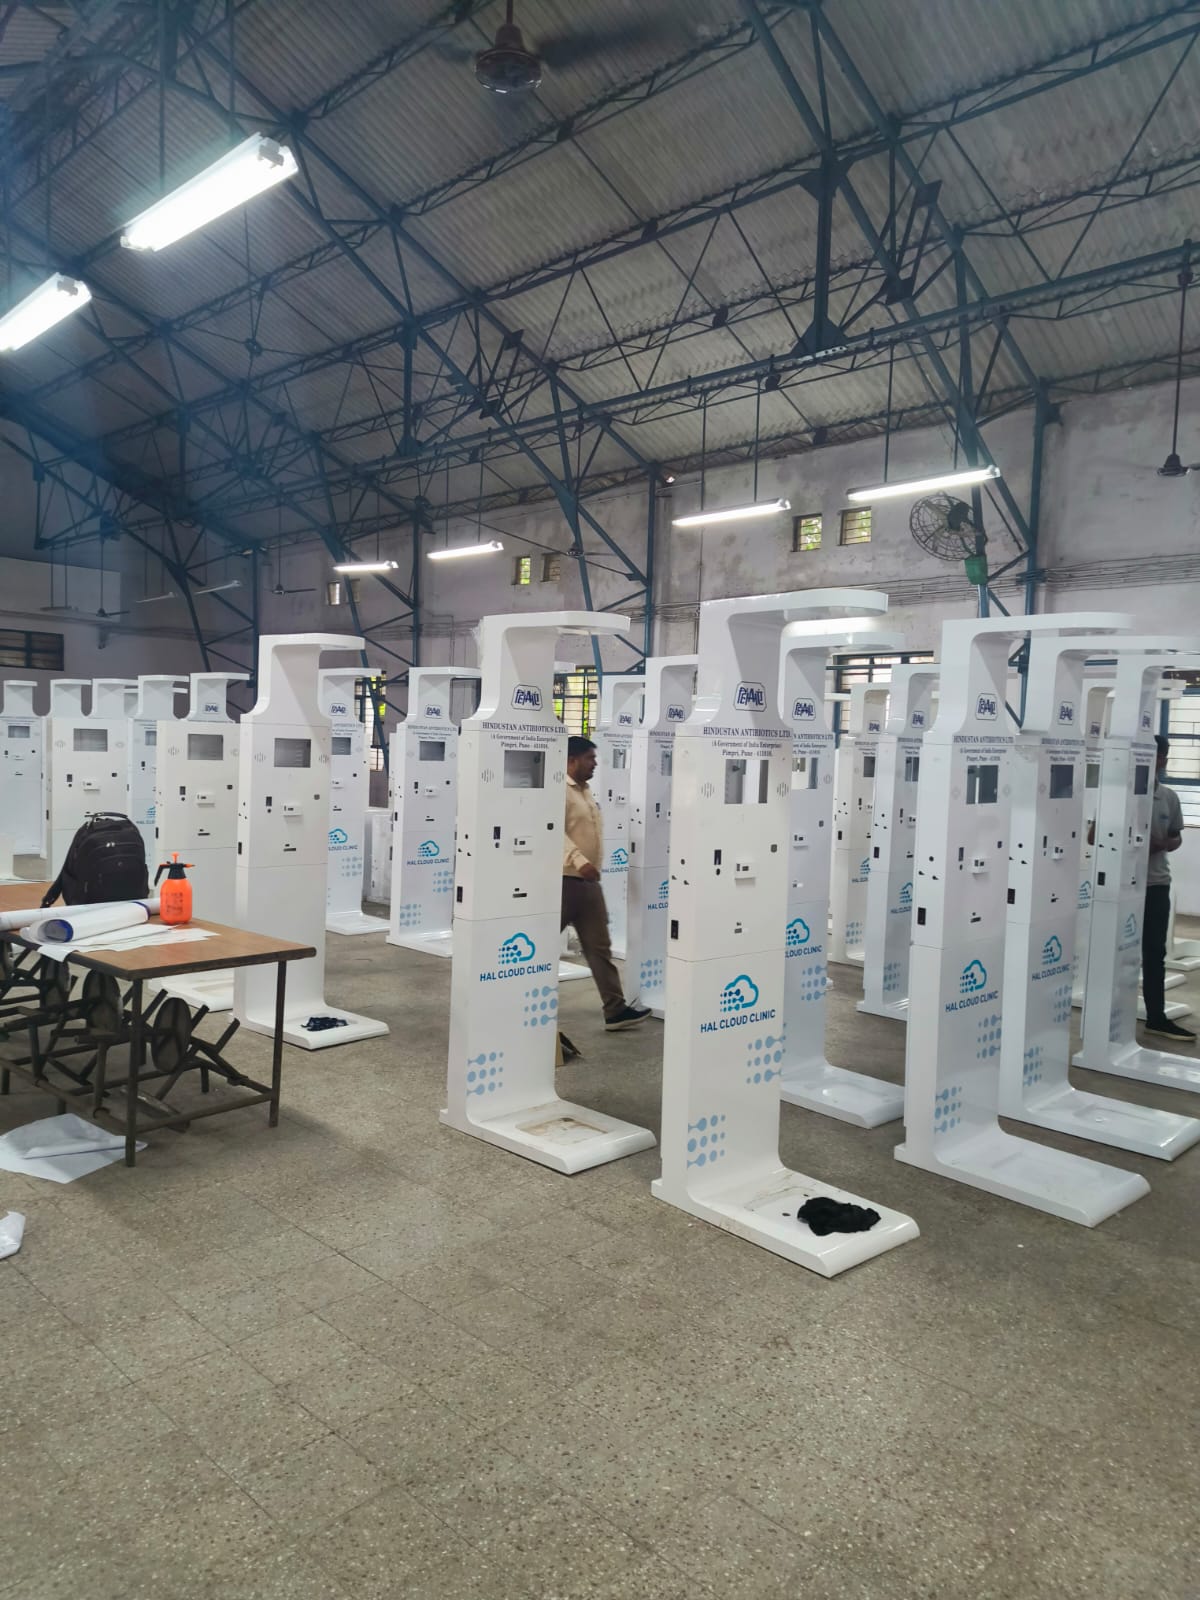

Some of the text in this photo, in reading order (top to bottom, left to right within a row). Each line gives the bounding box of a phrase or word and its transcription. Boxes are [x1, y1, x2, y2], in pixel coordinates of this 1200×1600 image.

[482, 722, 517, 731] HINDUSTAN
[519, 724, 554, 733] ANTIBIOTICS
[703, 726, 740, 737] HINDUSTAN
[740, 728, 778, 738] ANTIBIOTICS
[647, 903, 658, 911] HAL
[803, 945, 822, 955] CLINIC
[479, 963, 552, 982] HAL CLOUD CLINIC
[945, 990, 999, 1013] HAL CLOUD CLINIC
[700, 1009, 776, 1033] HAL CLOUD CLINIC
